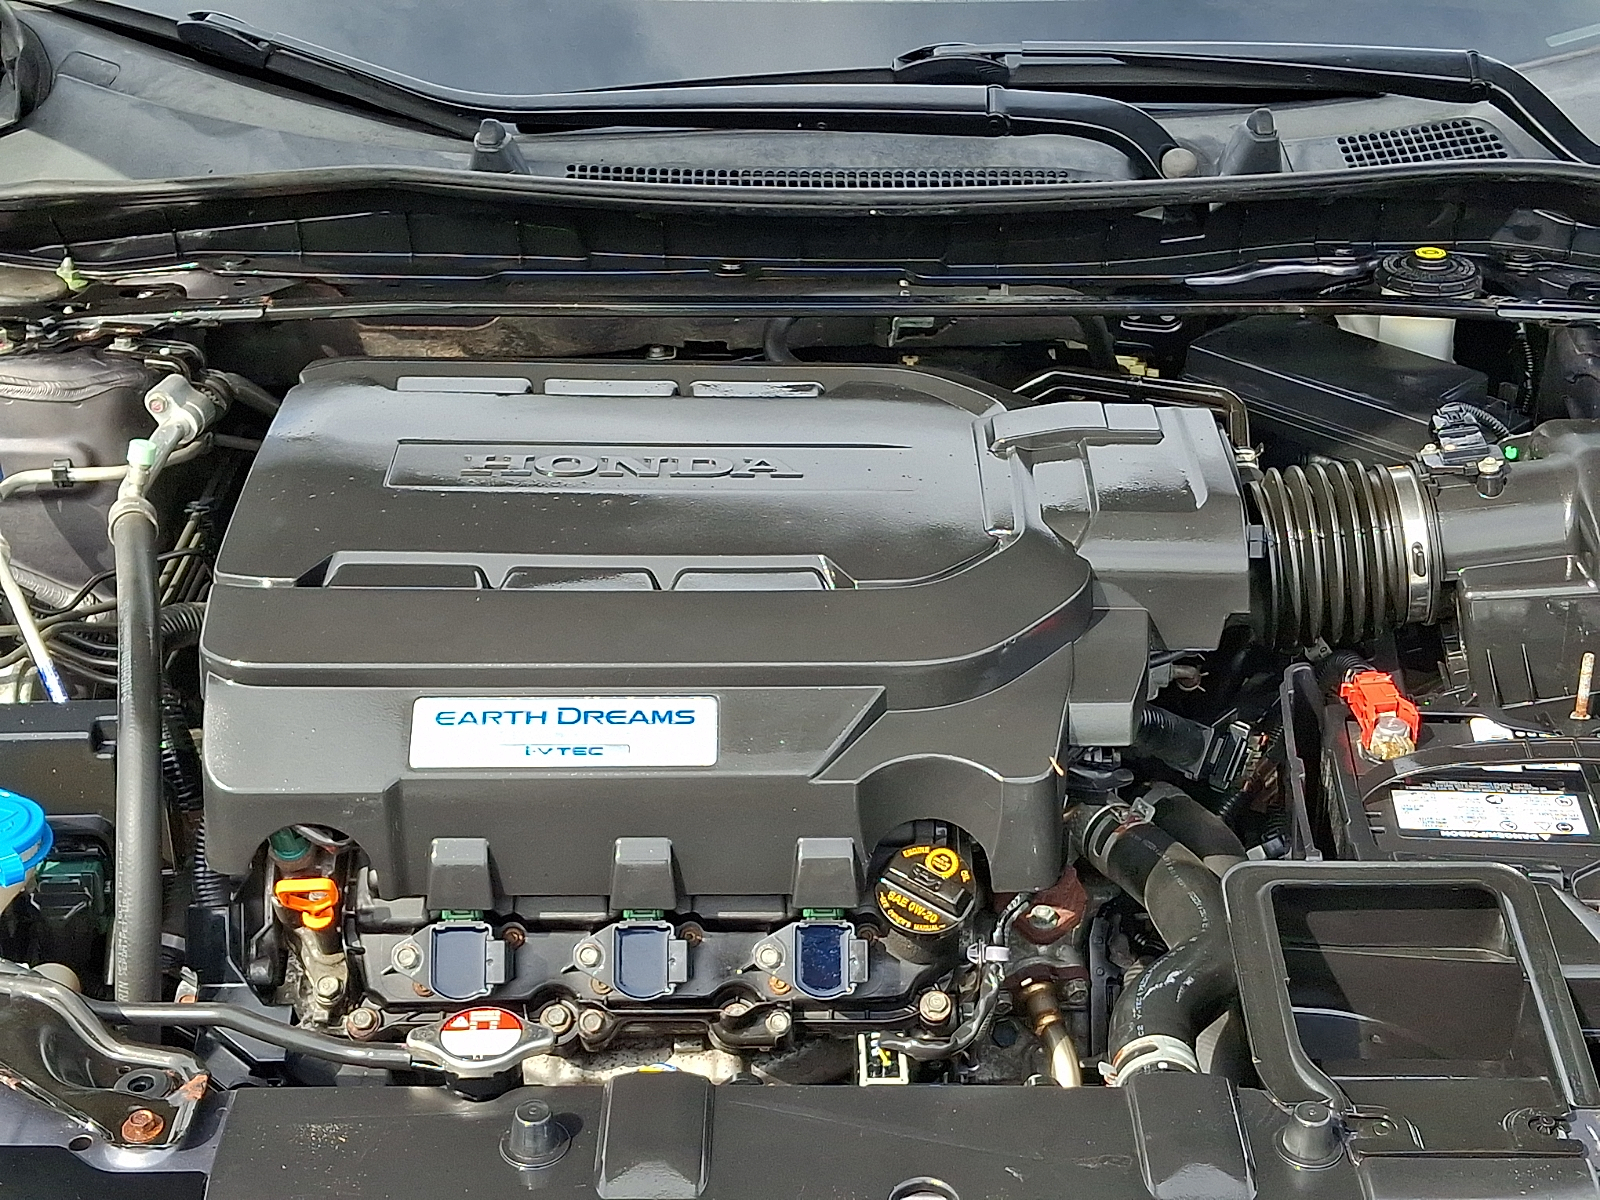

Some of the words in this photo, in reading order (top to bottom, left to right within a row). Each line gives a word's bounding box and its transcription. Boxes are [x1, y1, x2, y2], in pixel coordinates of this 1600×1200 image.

[461, 454, 803, 478] HONDA
[435, 710, 548, 726] EARTH
[887, 890, 910, 908] SAE
[908, 901, 939, 924] 0W-20
